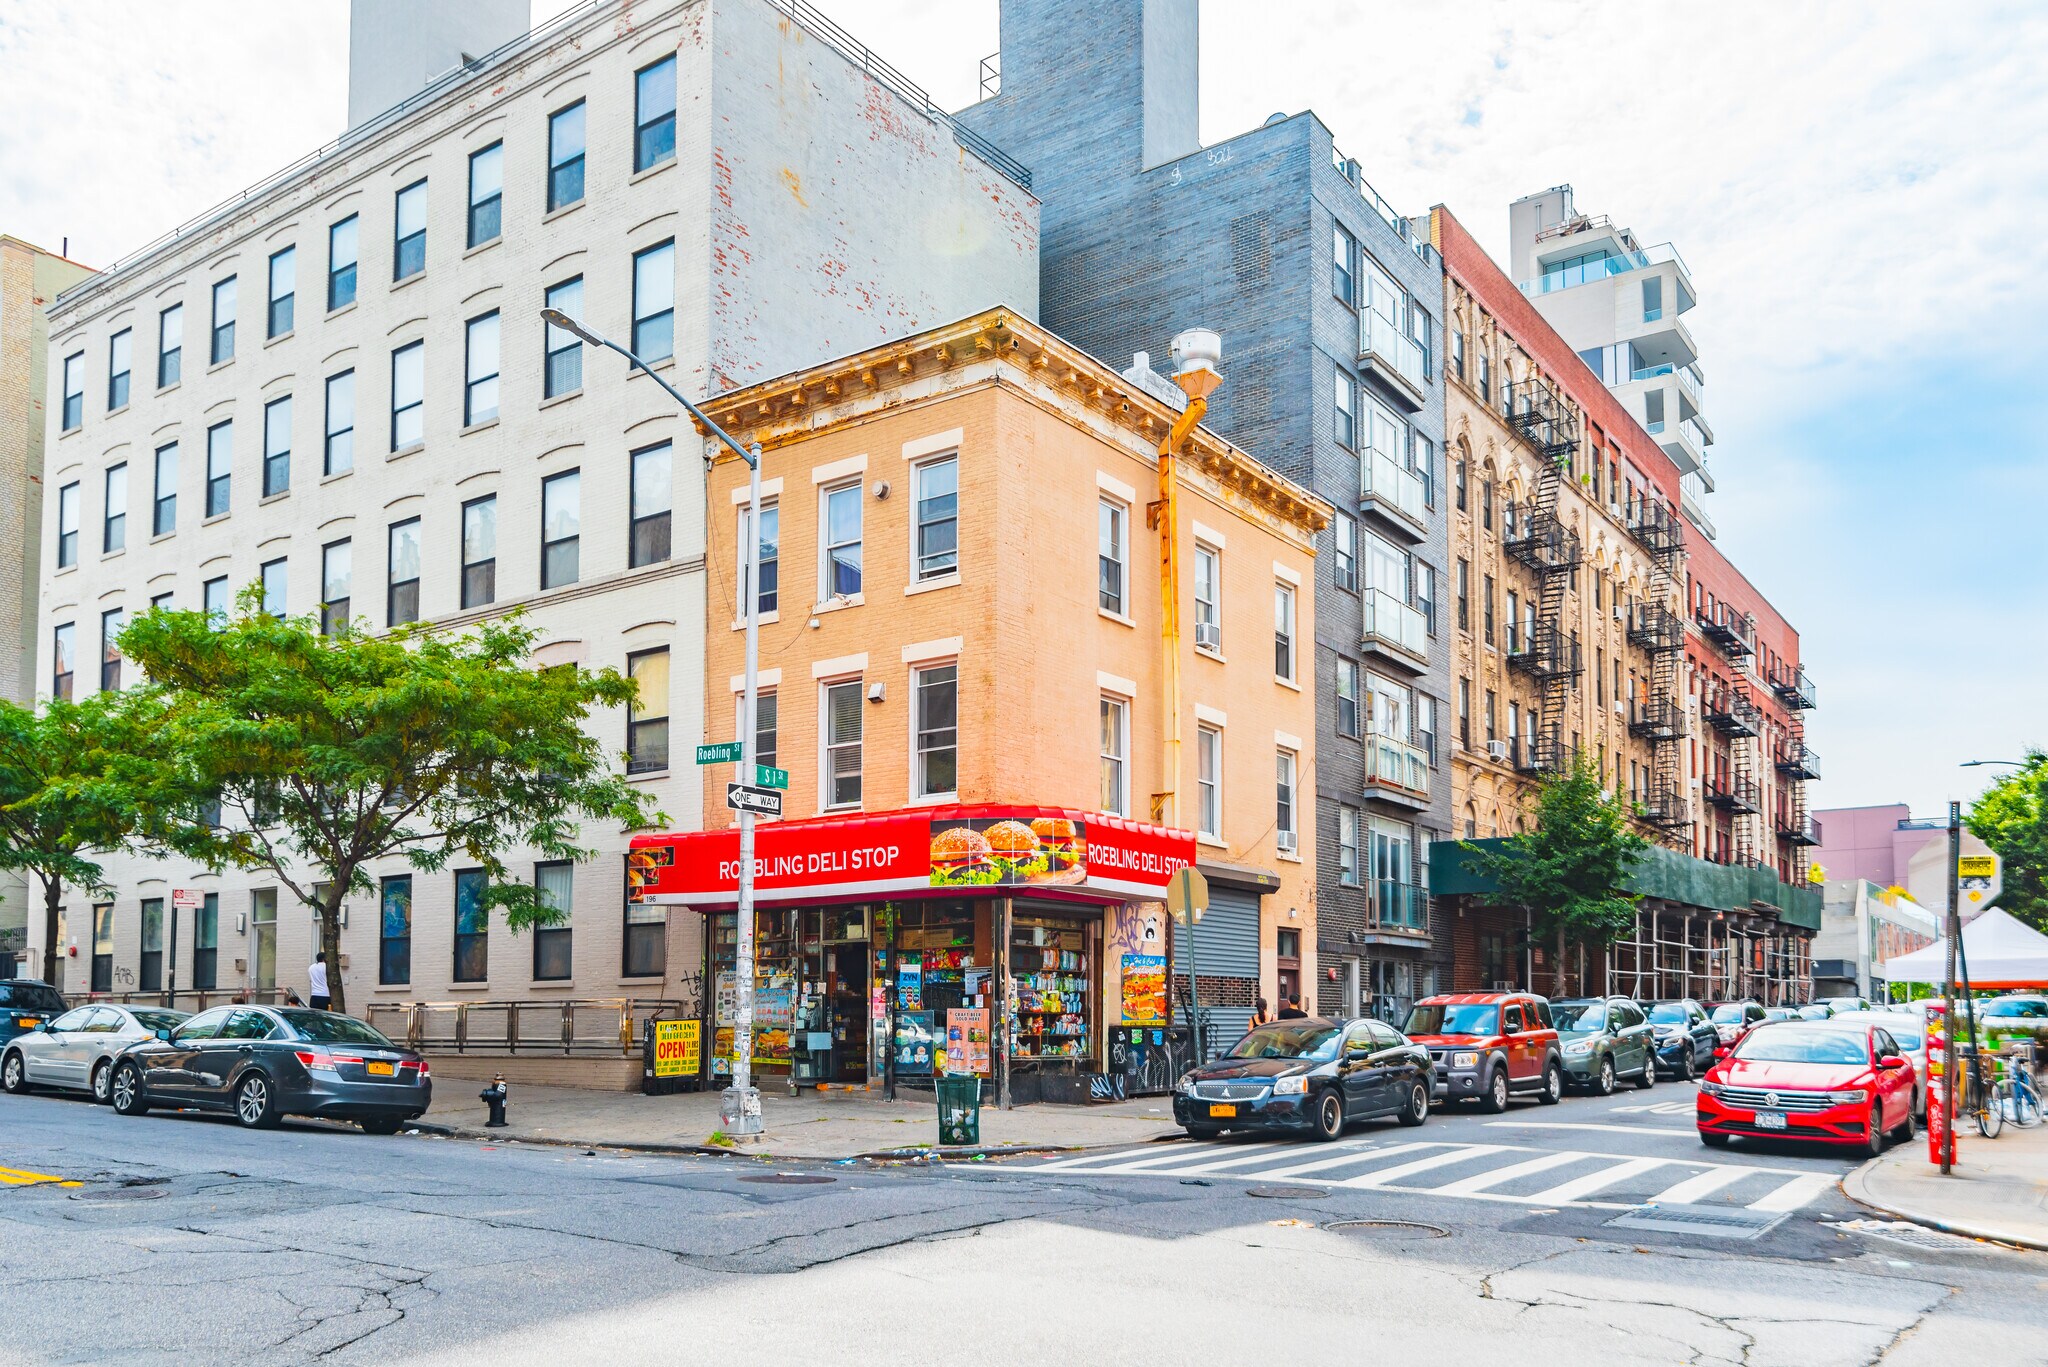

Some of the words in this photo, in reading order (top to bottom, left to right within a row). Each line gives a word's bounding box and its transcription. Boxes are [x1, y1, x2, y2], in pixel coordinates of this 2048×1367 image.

[698, 746, 731, 761] Roebling
[734, 743, 740, 752] St
[764, 769, 770, 783] S
[772, 771, 776, 784] 1
[734, 792, 752, 804] ONE
[760, 796, 777, 807] WAY
[719, 855, 803, 880] ROBLING
[808, 850, 848, 874] DELI
[851, 845, 899, 869] STOP
[1088, 843, 1140, 871] ROEBLING
[1141, 852, 1163, 874] DELI
[646, 895, 657, 903] 196
[903, 973, 918, 981] ZYN
[658, 1041, 686, 1059] OPEN
